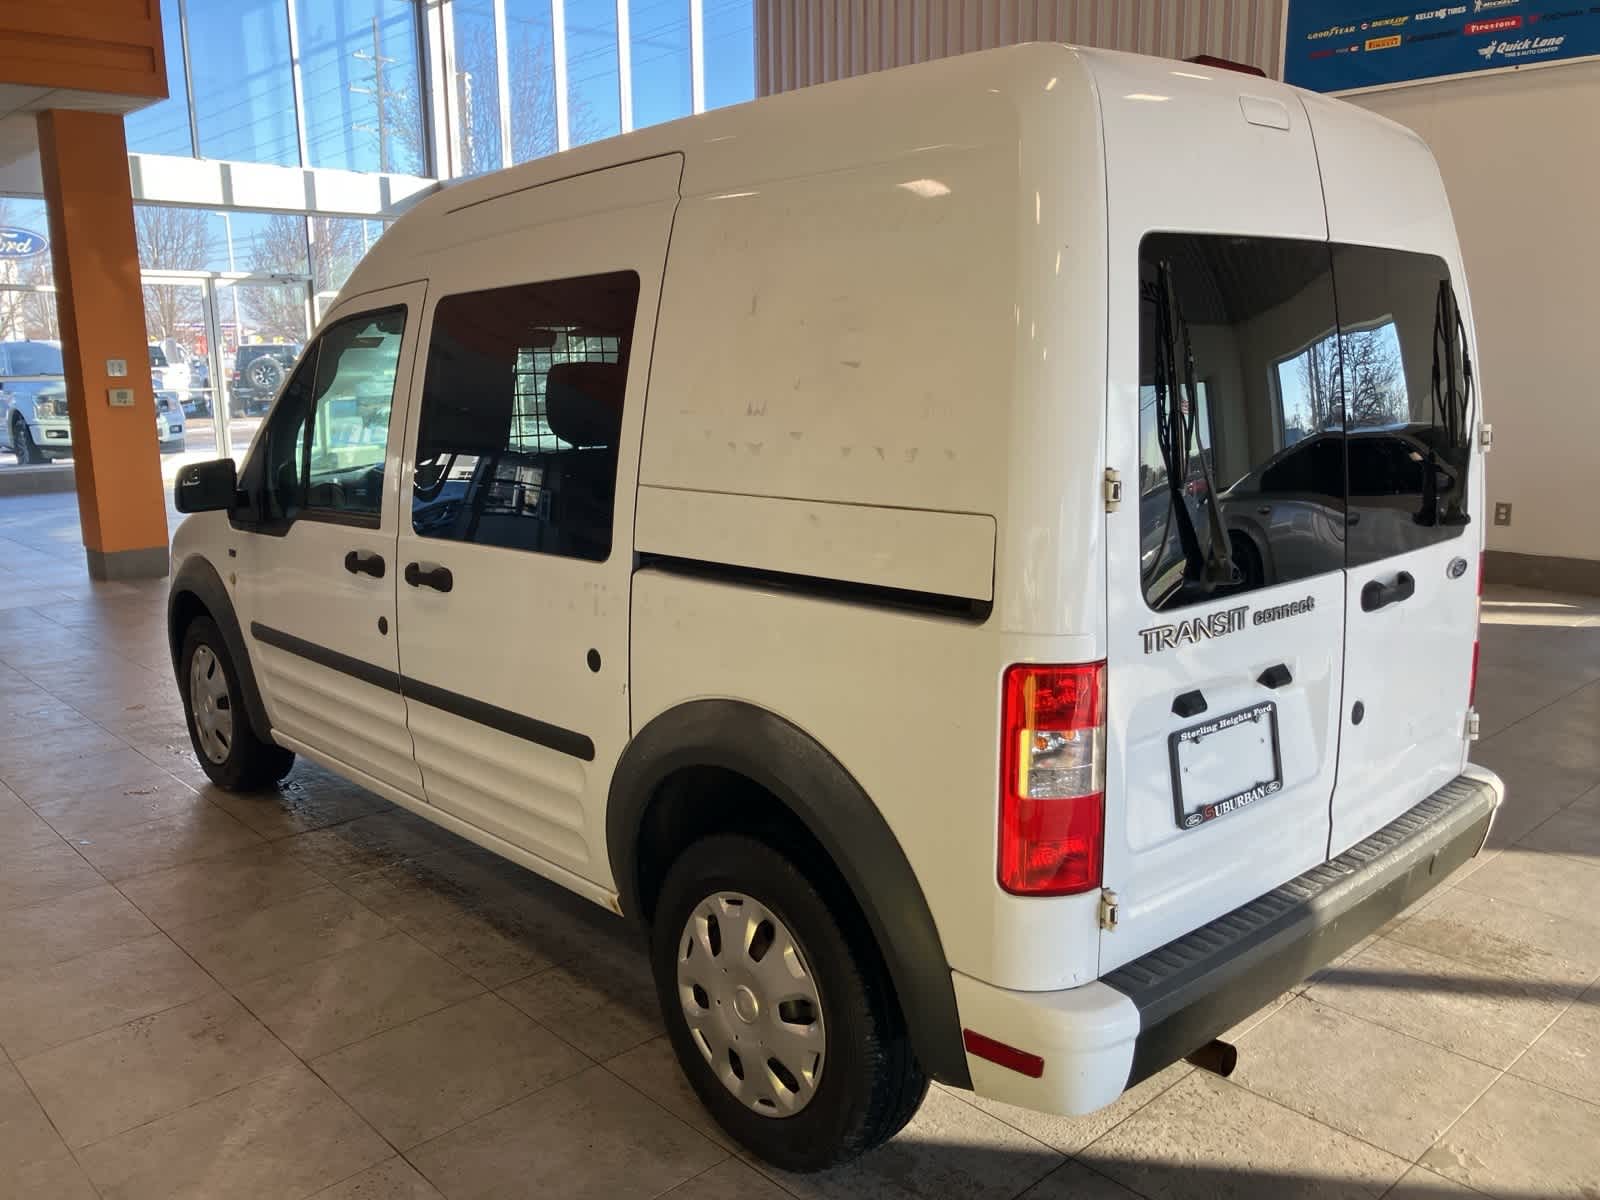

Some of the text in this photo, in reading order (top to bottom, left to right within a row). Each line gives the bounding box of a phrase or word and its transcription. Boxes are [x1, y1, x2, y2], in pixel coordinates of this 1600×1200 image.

[1414, 6, 1467, 20] KELLY TIRES
[1372, 16, 1409, 27] DUNLOP
[1470, 20, 1517, 33] Firestone
[1307, 26, 1356, 40] GOODYEAR
[1497, 36, 1564, 54] Quick Lane
[1138, 595, 1315, 655] TRANSIT connect
[1180, 704, 1272, 741] Sterling Heights Ford
[1205, 786, 1265, 821] SUBURBAN
